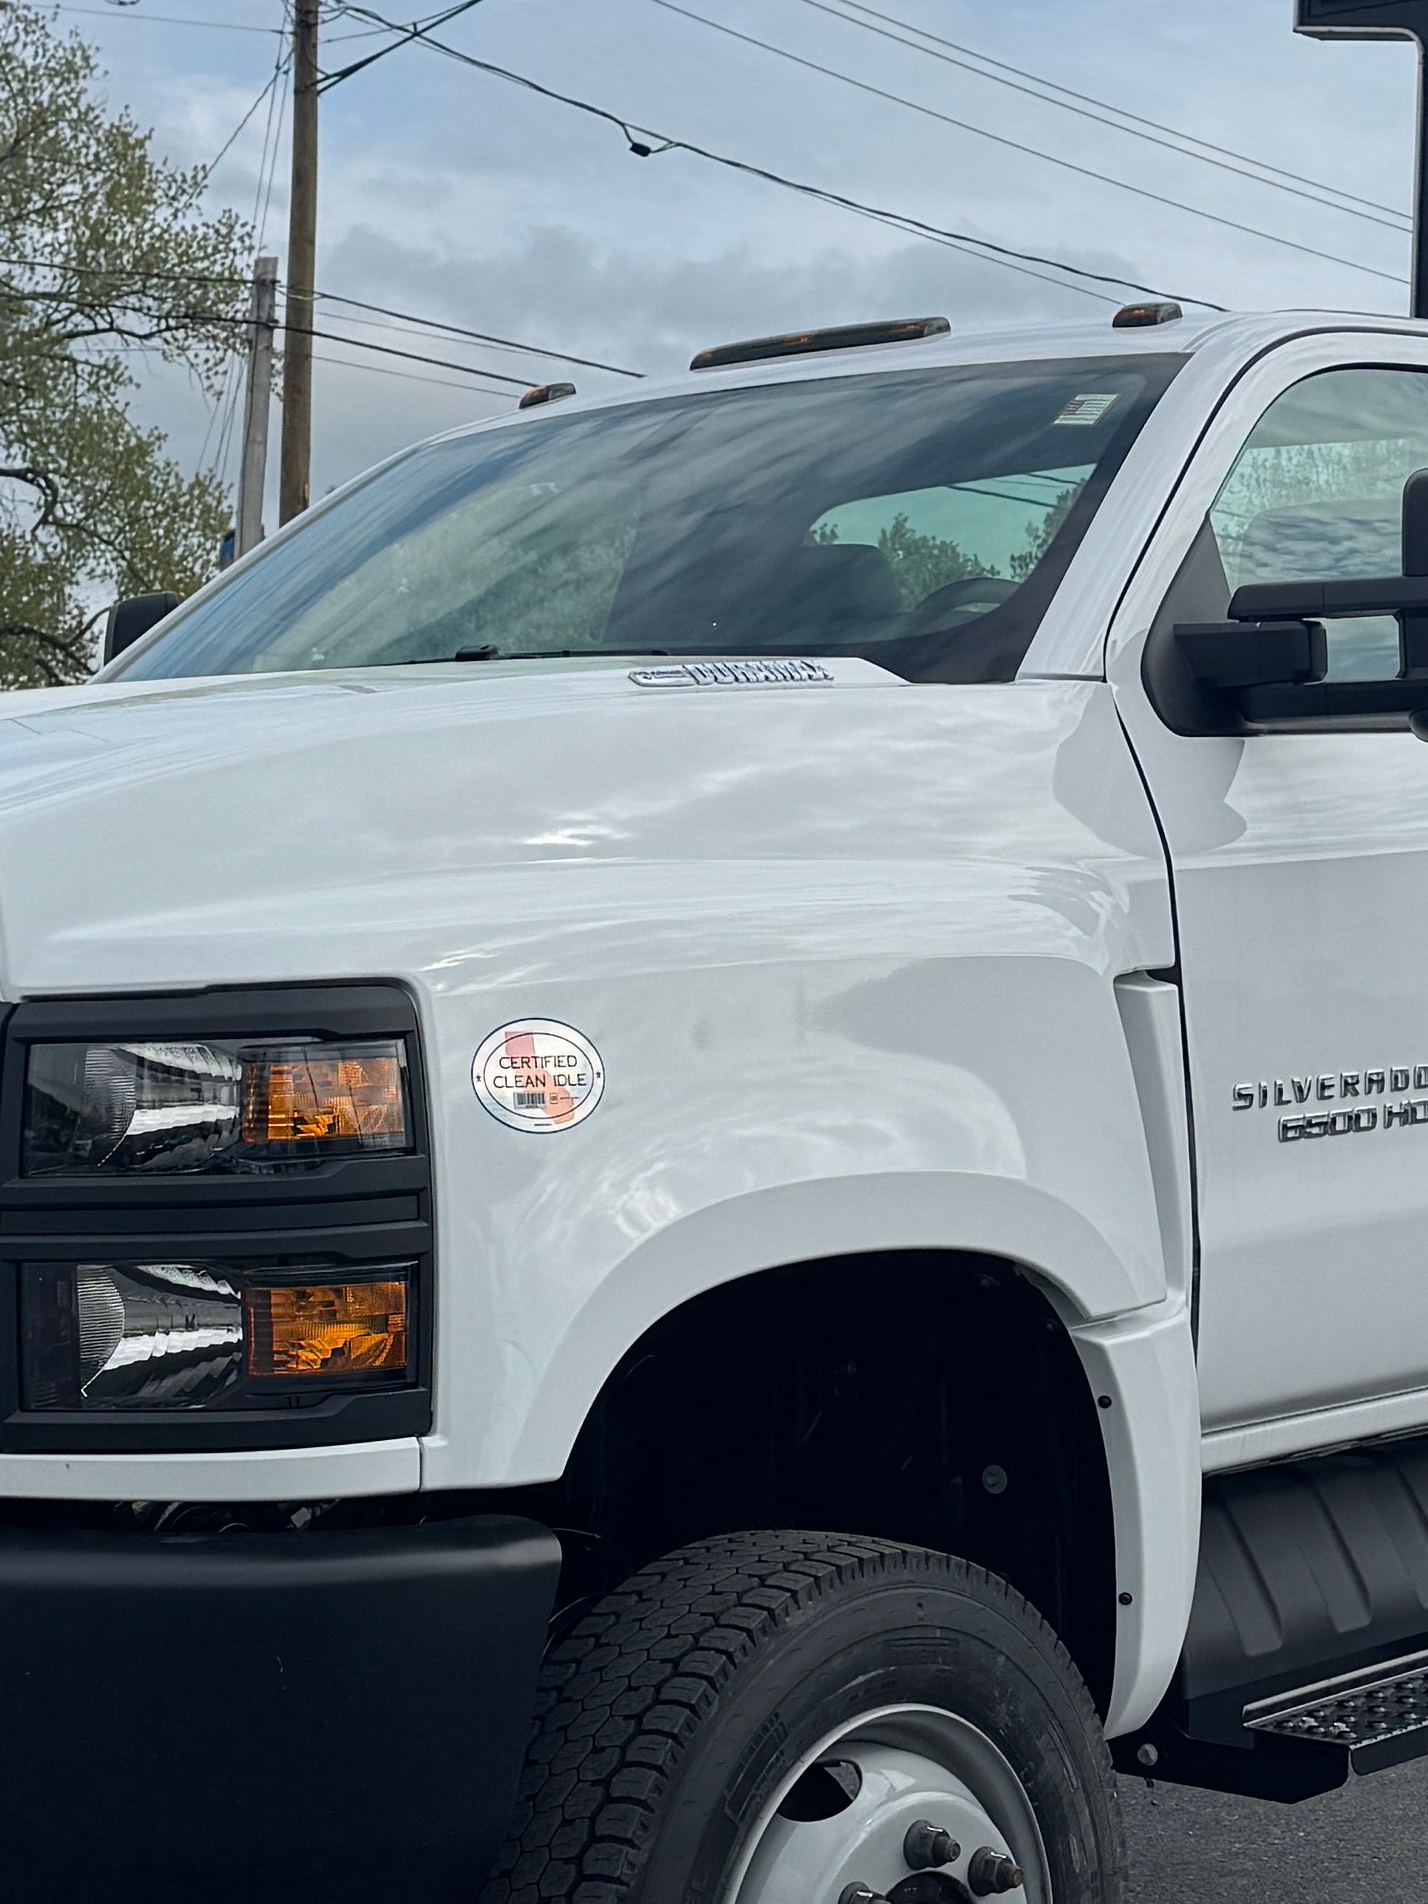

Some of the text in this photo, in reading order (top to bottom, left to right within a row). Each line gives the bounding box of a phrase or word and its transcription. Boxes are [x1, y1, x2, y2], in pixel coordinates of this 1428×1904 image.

[499, 1055, 577, 1069] CERTIFIED
[493, 1073, 587, 1088] CLEAN IDLE
[1278, 1105, 1377, 1143] 6500
